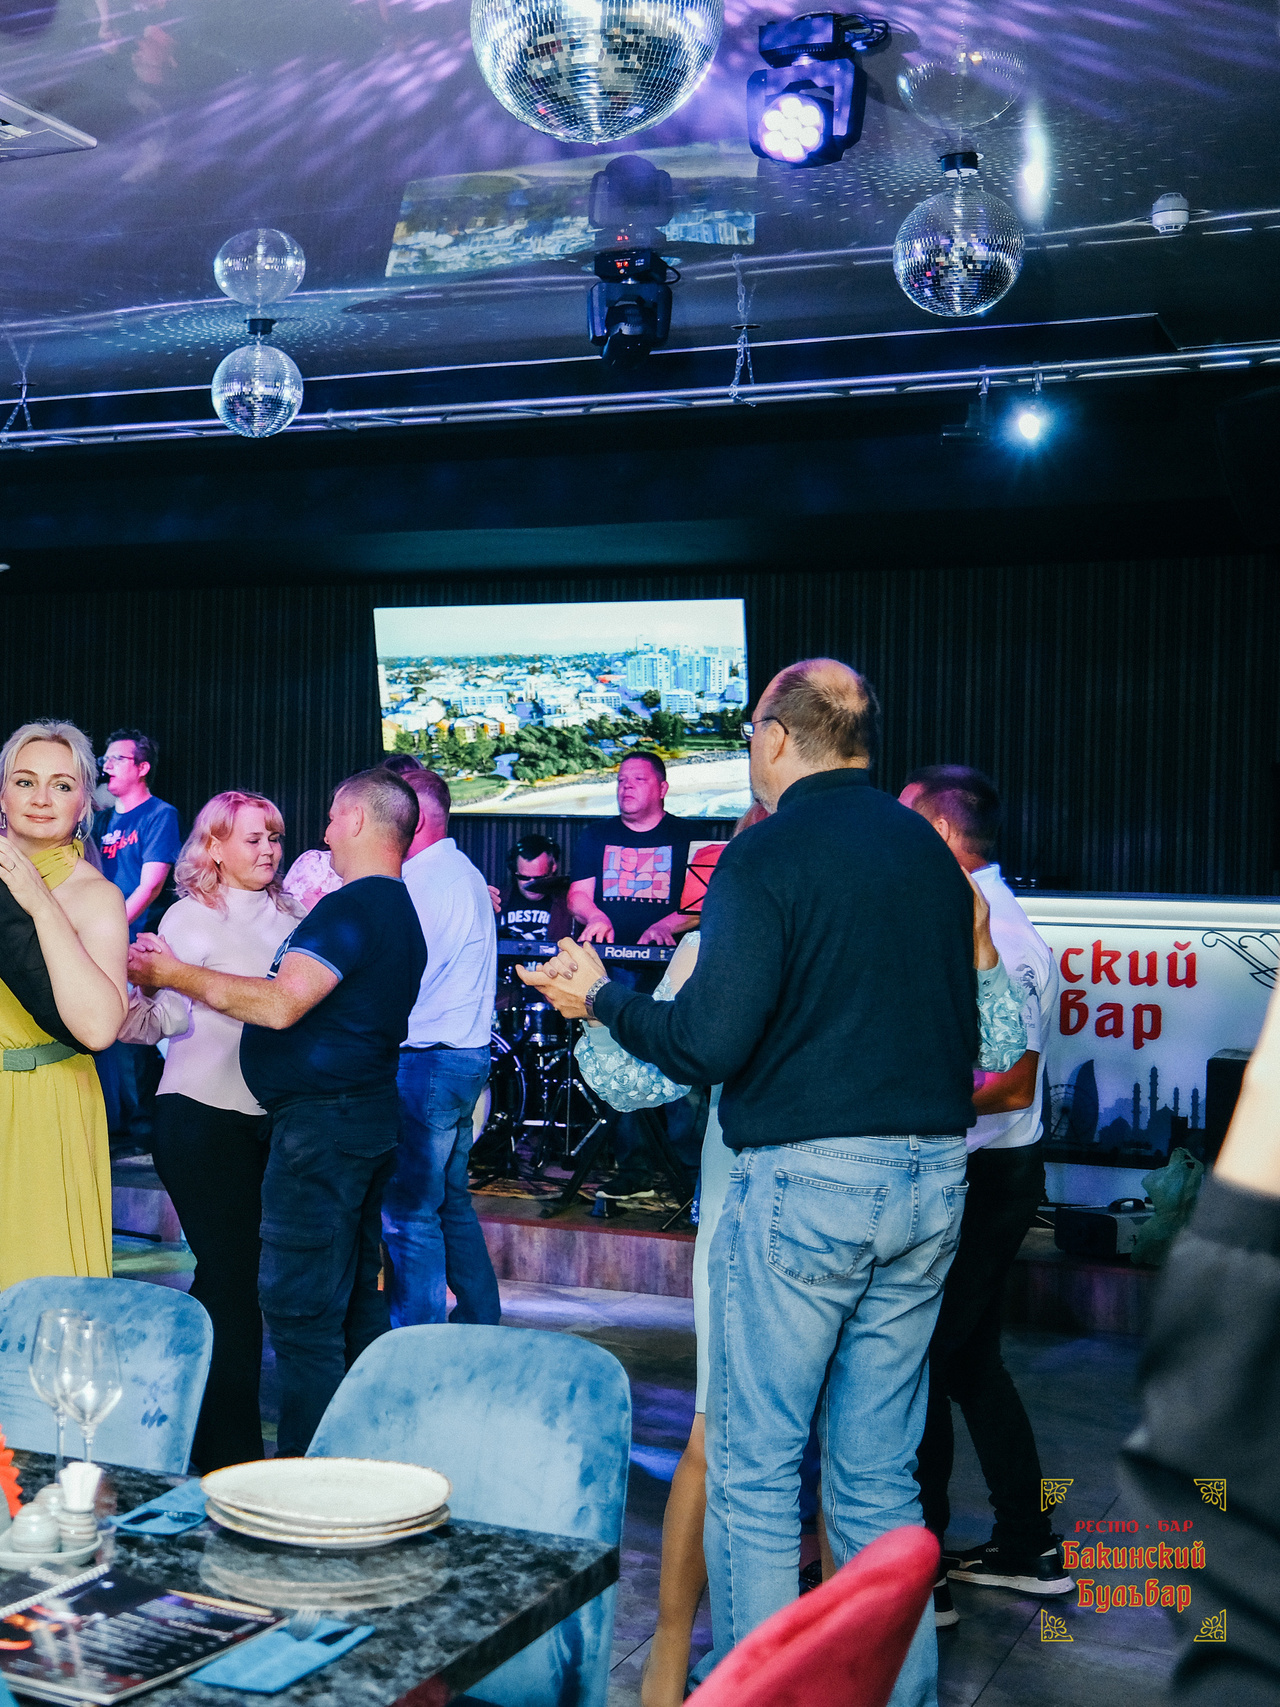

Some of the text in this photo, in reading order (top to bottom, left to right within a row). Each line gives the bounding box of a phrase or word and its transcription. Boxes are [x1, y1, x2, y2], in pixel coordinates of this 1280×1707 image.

[602, 897, 670, 905] NORTHLAND
[604, 946, 651, 959] Roland
[1059, 939, 1198, 988] ский
[1058, 989, 1162, 1050] вар
